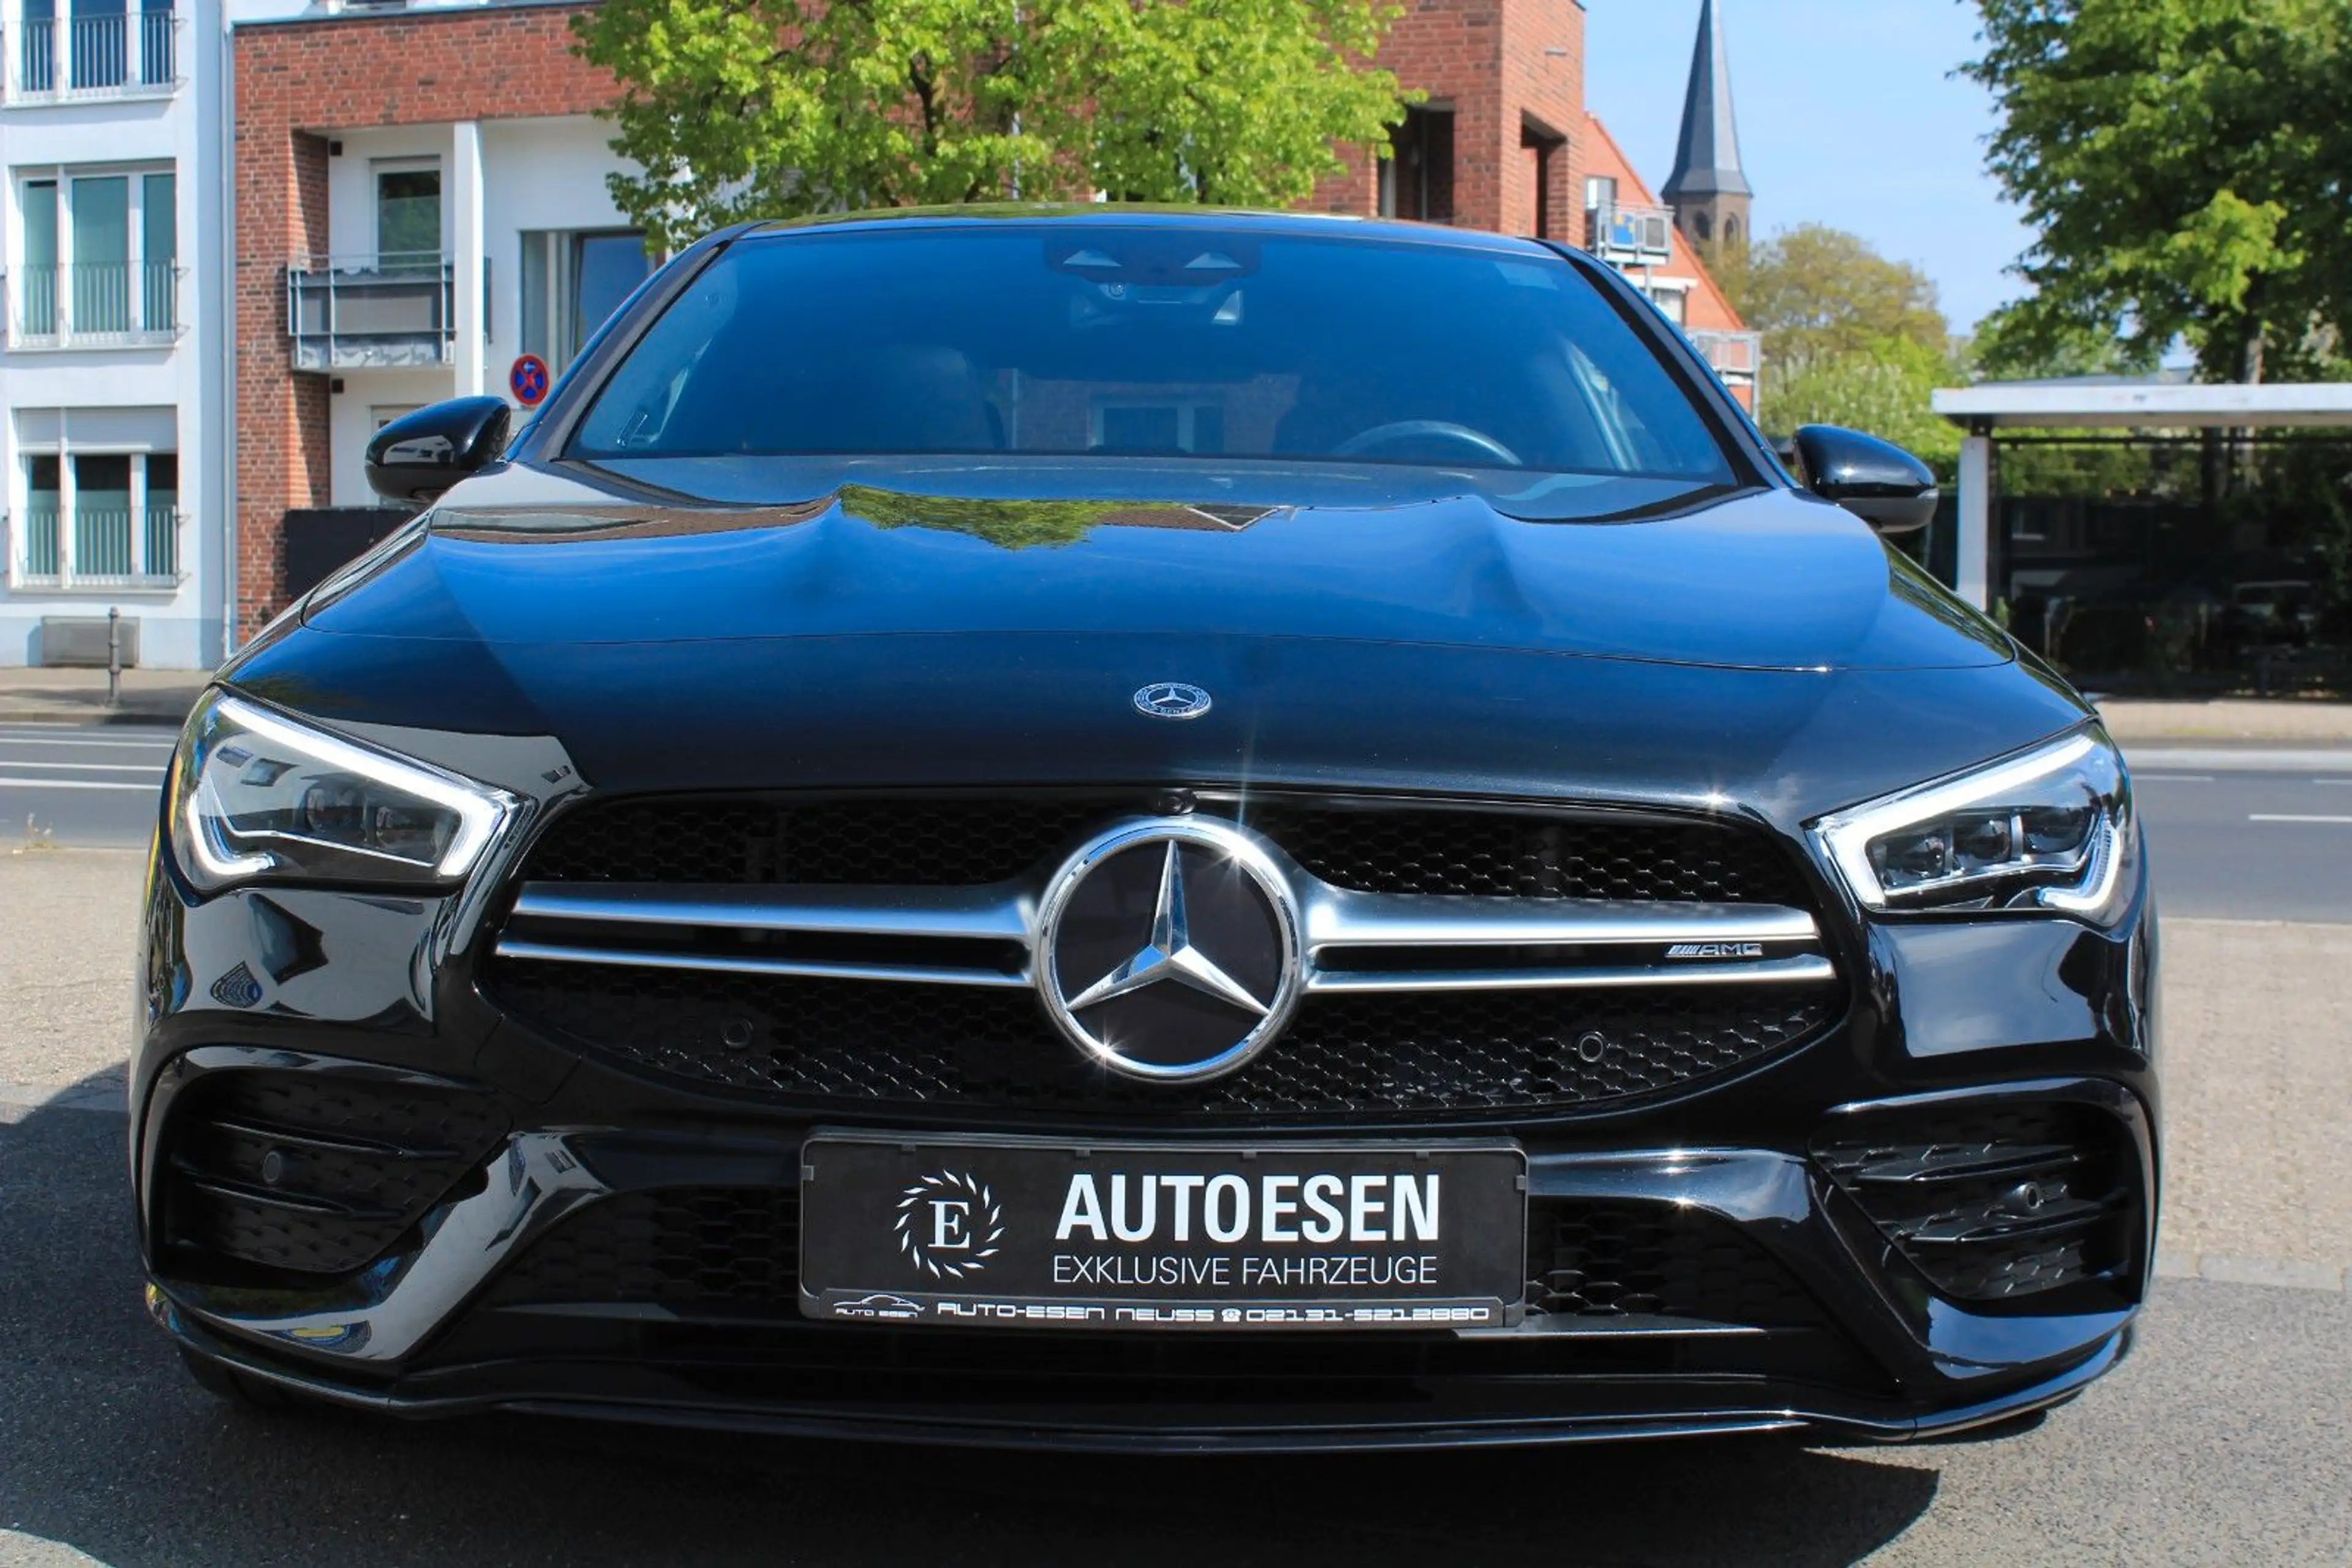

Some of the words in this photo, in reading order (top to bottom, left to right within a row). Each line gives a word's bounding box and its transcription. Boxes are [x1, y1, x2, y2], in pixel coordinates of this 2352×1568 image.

[927, 1200, 970, 1248] E
[1054, 1255, 1230, 1285] EXKLUSIVE
[1242, 1256, 1438, 1285] FAHRZEUGE
[835, 1308, 875, 1317] AUTO
[937, 1302, 1105, 1320] AUTO-ESEN
[1115, 1307, 1215, 1322] NEUSS
